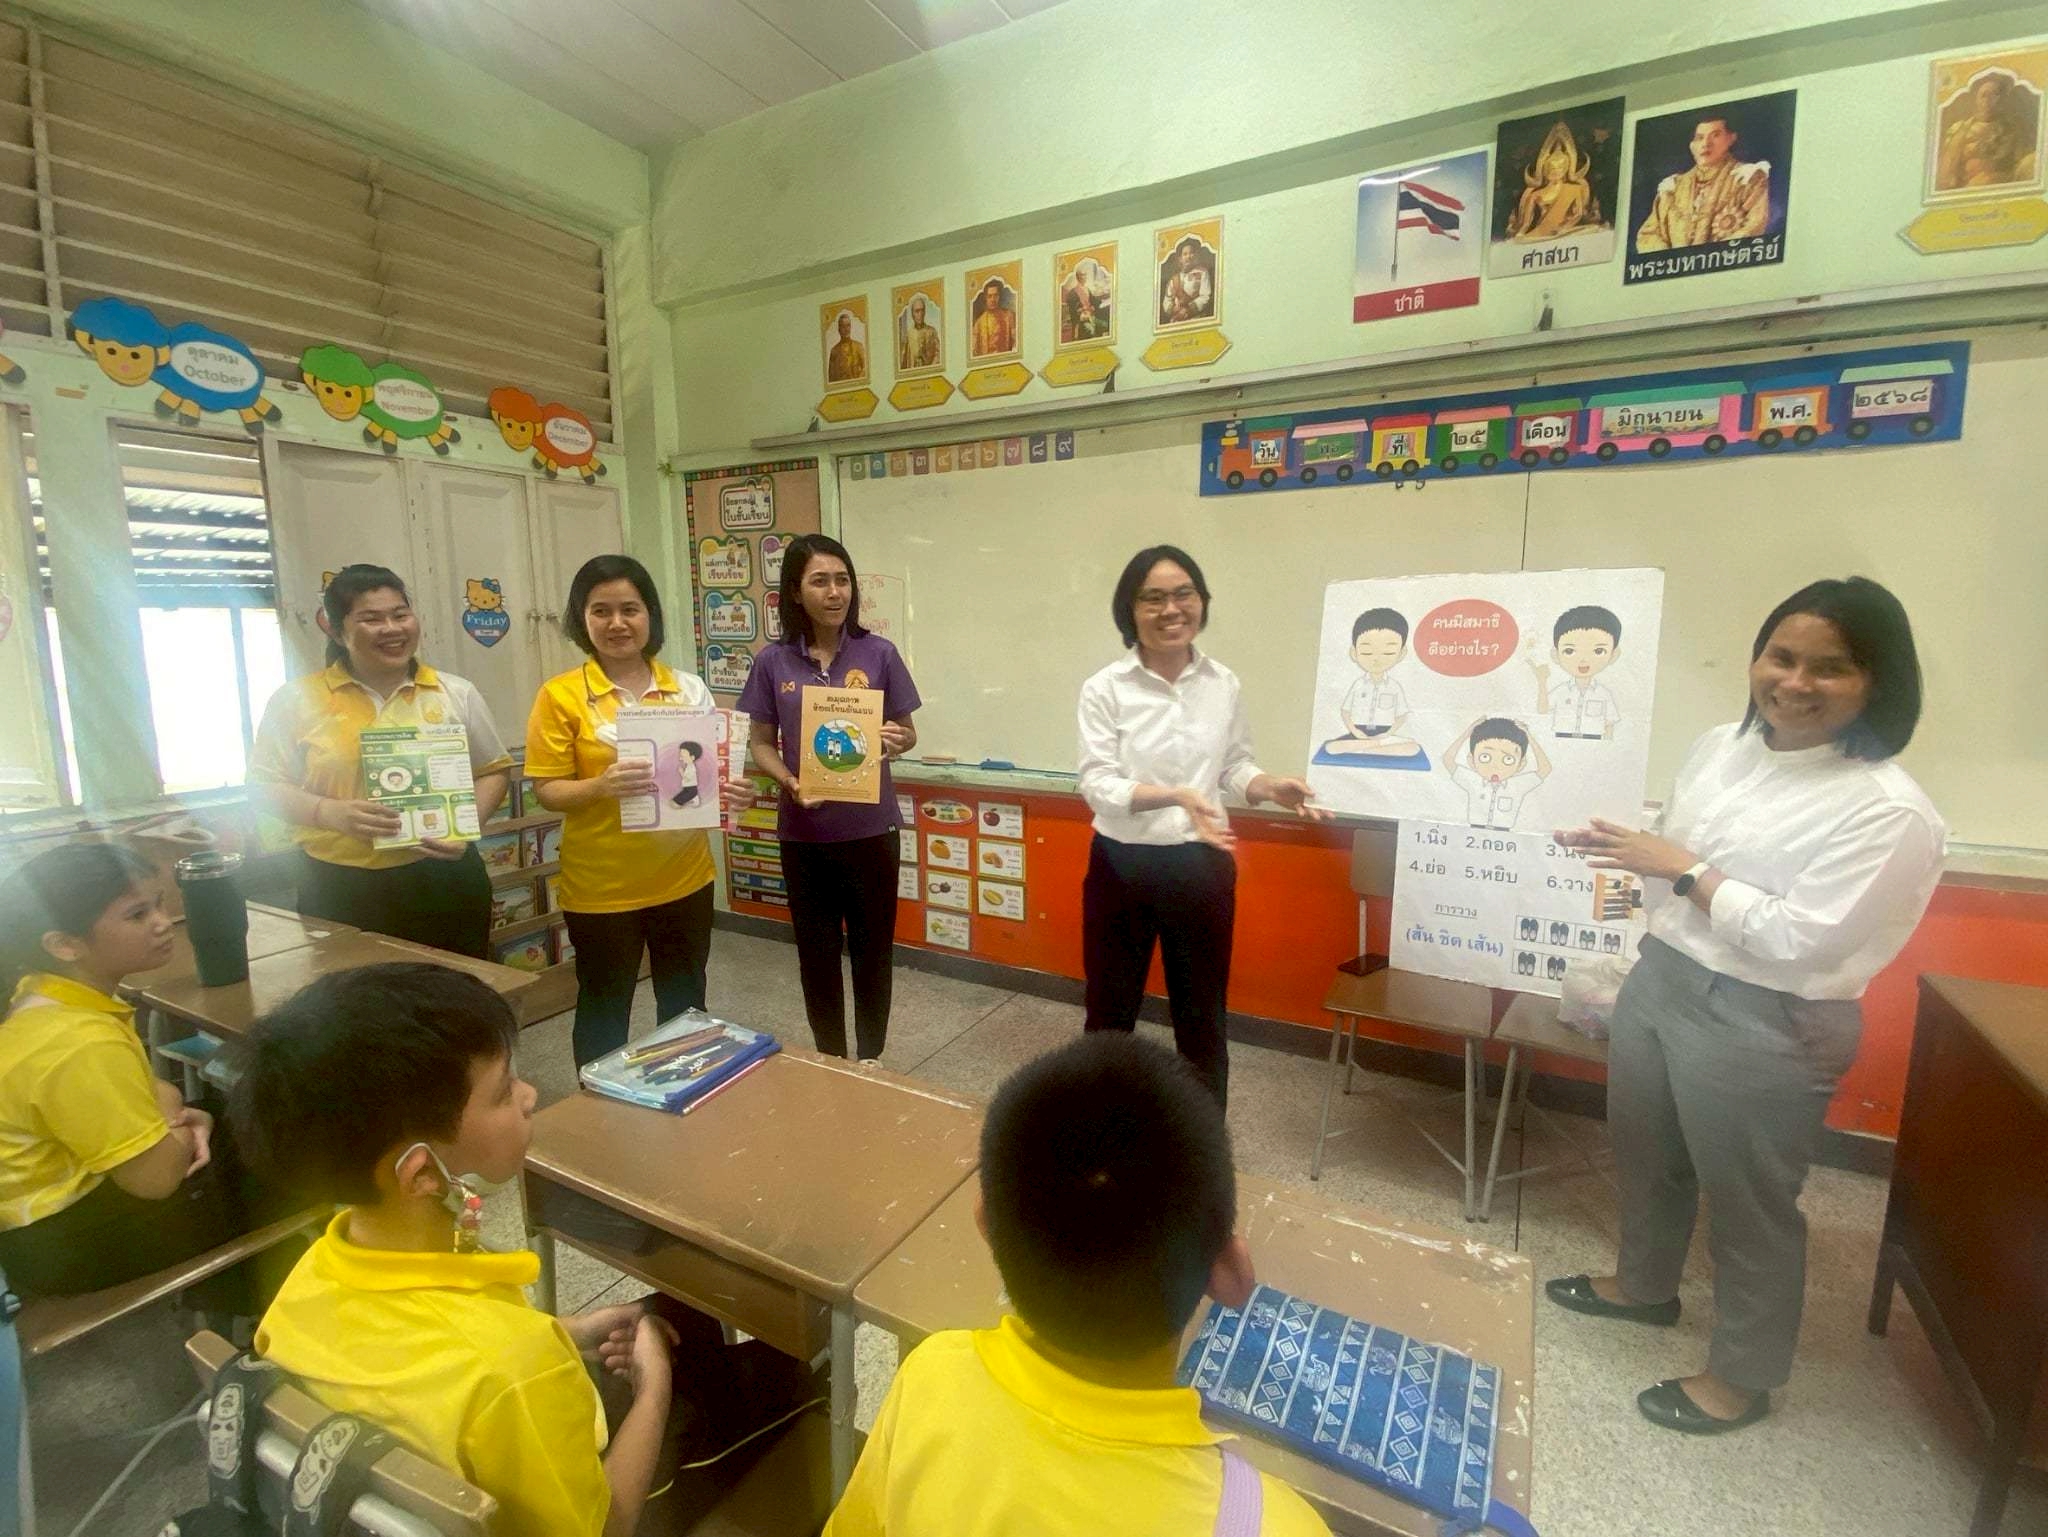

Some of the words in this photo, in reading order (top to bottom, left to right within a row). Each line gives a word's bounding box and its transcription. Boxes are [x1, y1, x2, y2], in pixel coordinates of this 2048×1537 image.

[1521, 245, 1579, 270] ศาสนา
[1628, 236, 1779, 281] พระมหากษัตริย์
[1394, 288, 1424, 312] ชาติ
[187, 346, 239, 365] ตุลาคม
[183, 364, 246, 387] October
[1260, 443, 1275, 459] วัน
[1392, 435, 1404, 455] ที่
[1452, 429, 1487, 448] ๒๕
[1525, 421, 1567, 442] เดือน
[1617, 407, 1704, 427] มิถุนายน
[1769, 402, 1812, 420] พ.ศ.
[1854, 386, 1928, 408] ๒๕๖๘
[724, 505, 769, 521] ในชั้นเรียน
[466, 613, 507, 627] Friday
[1433, 612, 1501, 629] คนมีสมาธิ
[1428, 638, 1500, 656] ดีอย่างไร?
[1415, 824, 1447, 846] 1.นิ่ง
[1465, 836, 1518, 853] 2.ถอด
[1409, 857, 1446, 875] 4.ย่อ
[1464, 864, 1519, 884] 5.หยิบ
[1546, 875, 1594, 893] 6.วาง
[1434, 903, 1478, 918] การวาง
[1439, 928, 1462, 948] ชิด
